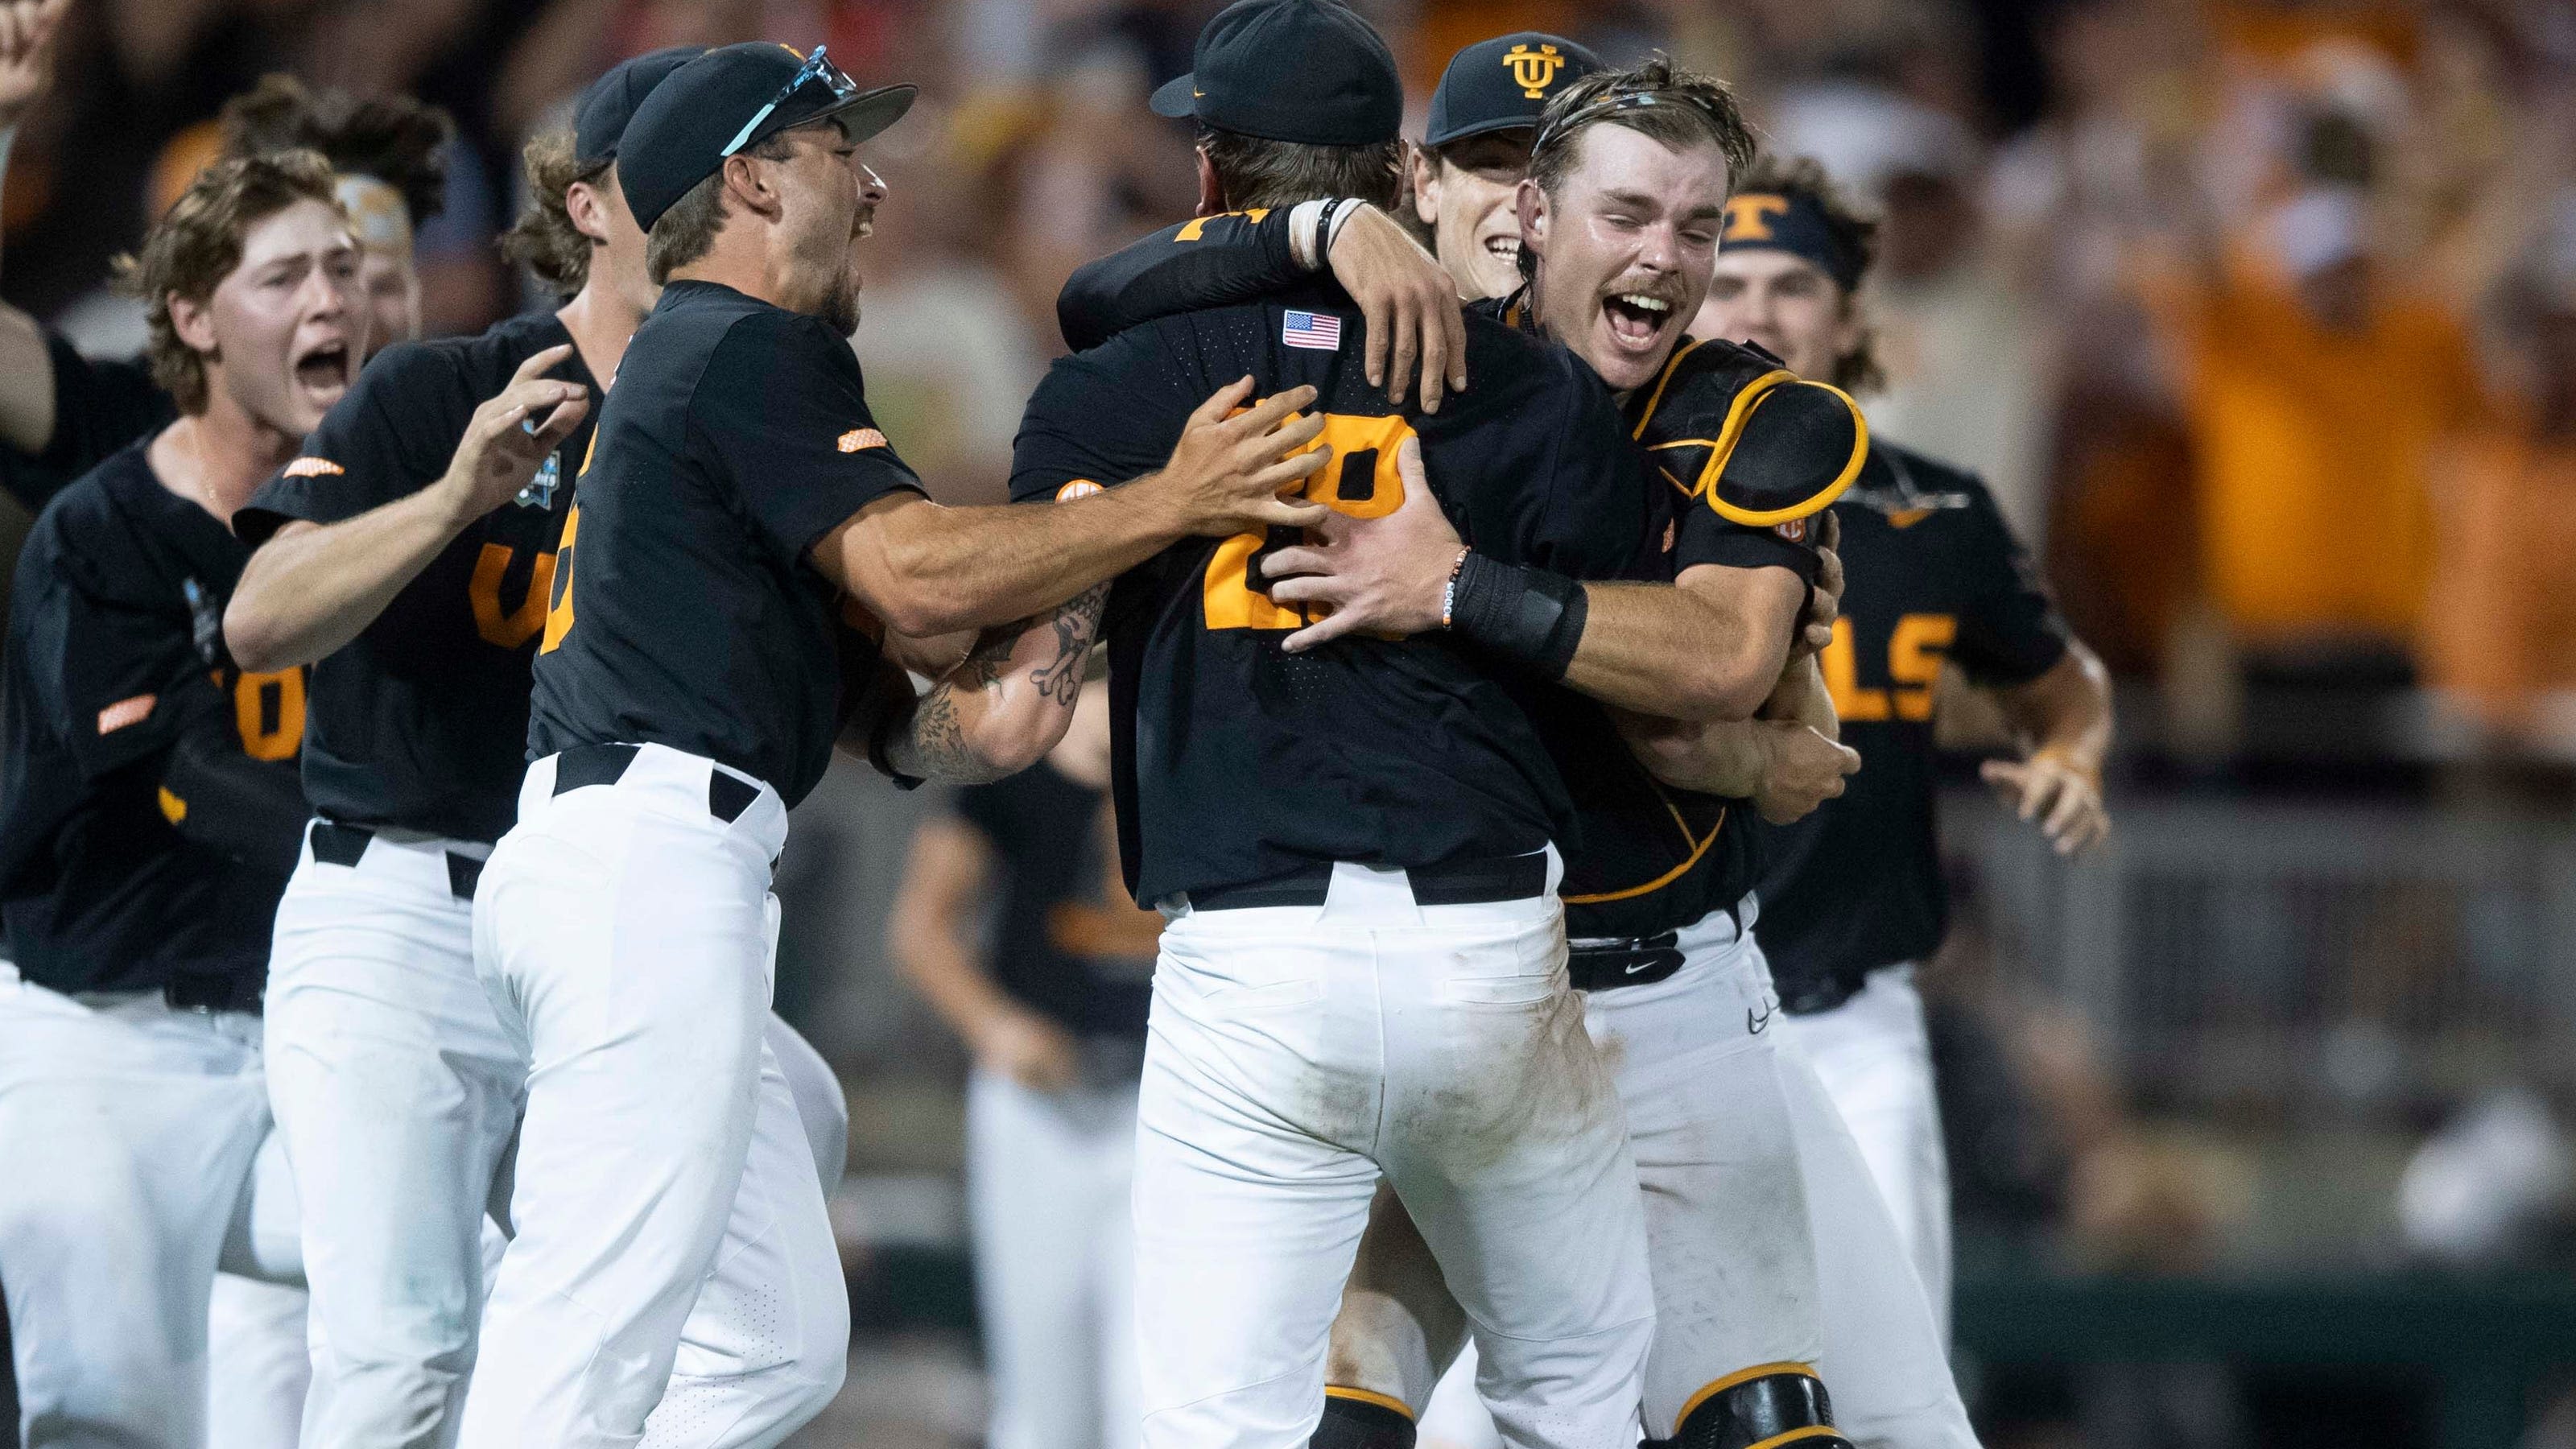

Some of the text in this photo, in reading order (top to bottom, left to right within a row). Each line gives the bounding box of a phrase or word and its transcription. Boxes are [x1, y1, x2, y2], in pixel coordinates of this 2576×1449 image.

[1502, 43, 1565, 99] UT
[1724, 193, 1789, 242] T
[1821, 613, 1958, 722] LS
